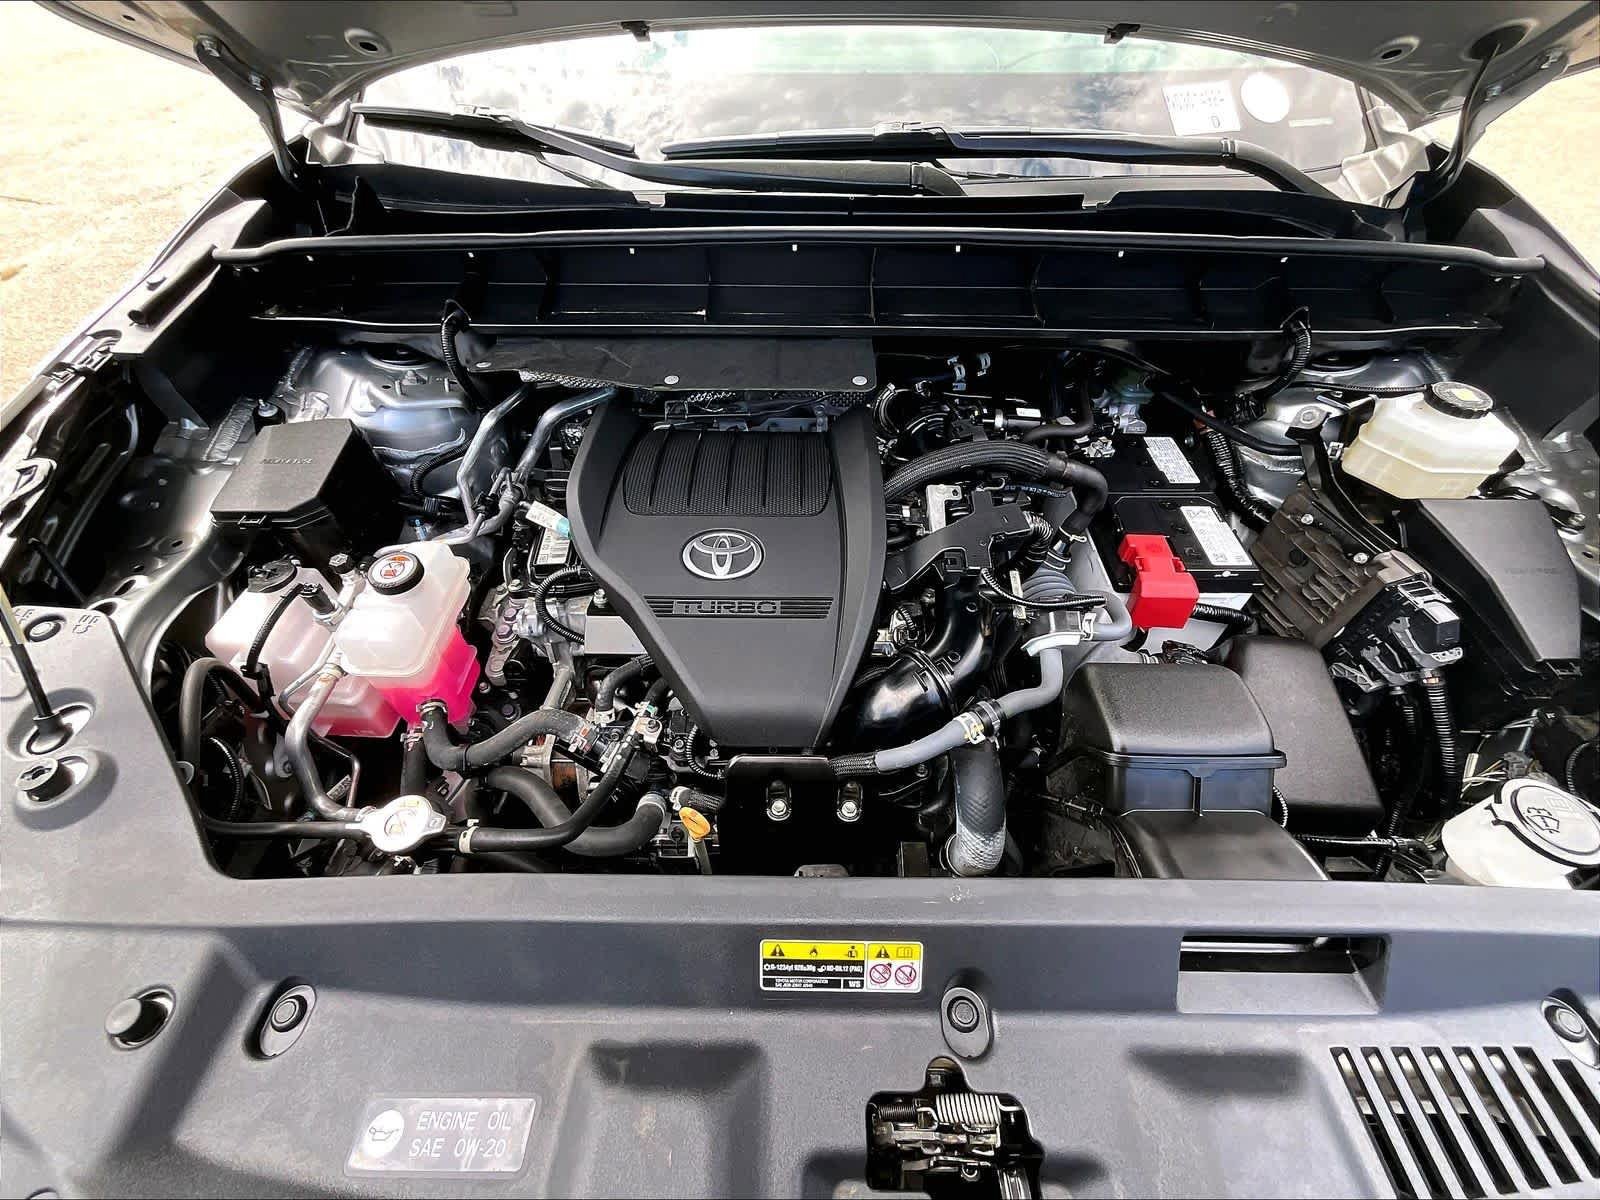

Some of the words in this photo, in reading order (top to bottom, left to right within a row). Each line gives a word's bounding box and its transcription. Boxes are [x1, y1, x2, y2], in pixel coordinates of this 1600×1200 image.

[675, 600, 777, 615] TURBO
[416, 1111, 479, 1130] ENGINE
[488, 1111, 512, 1130] OIL
[408, 1137, 445, 1158] SAE
[454, 1138, 506, 1158] 0W-20
